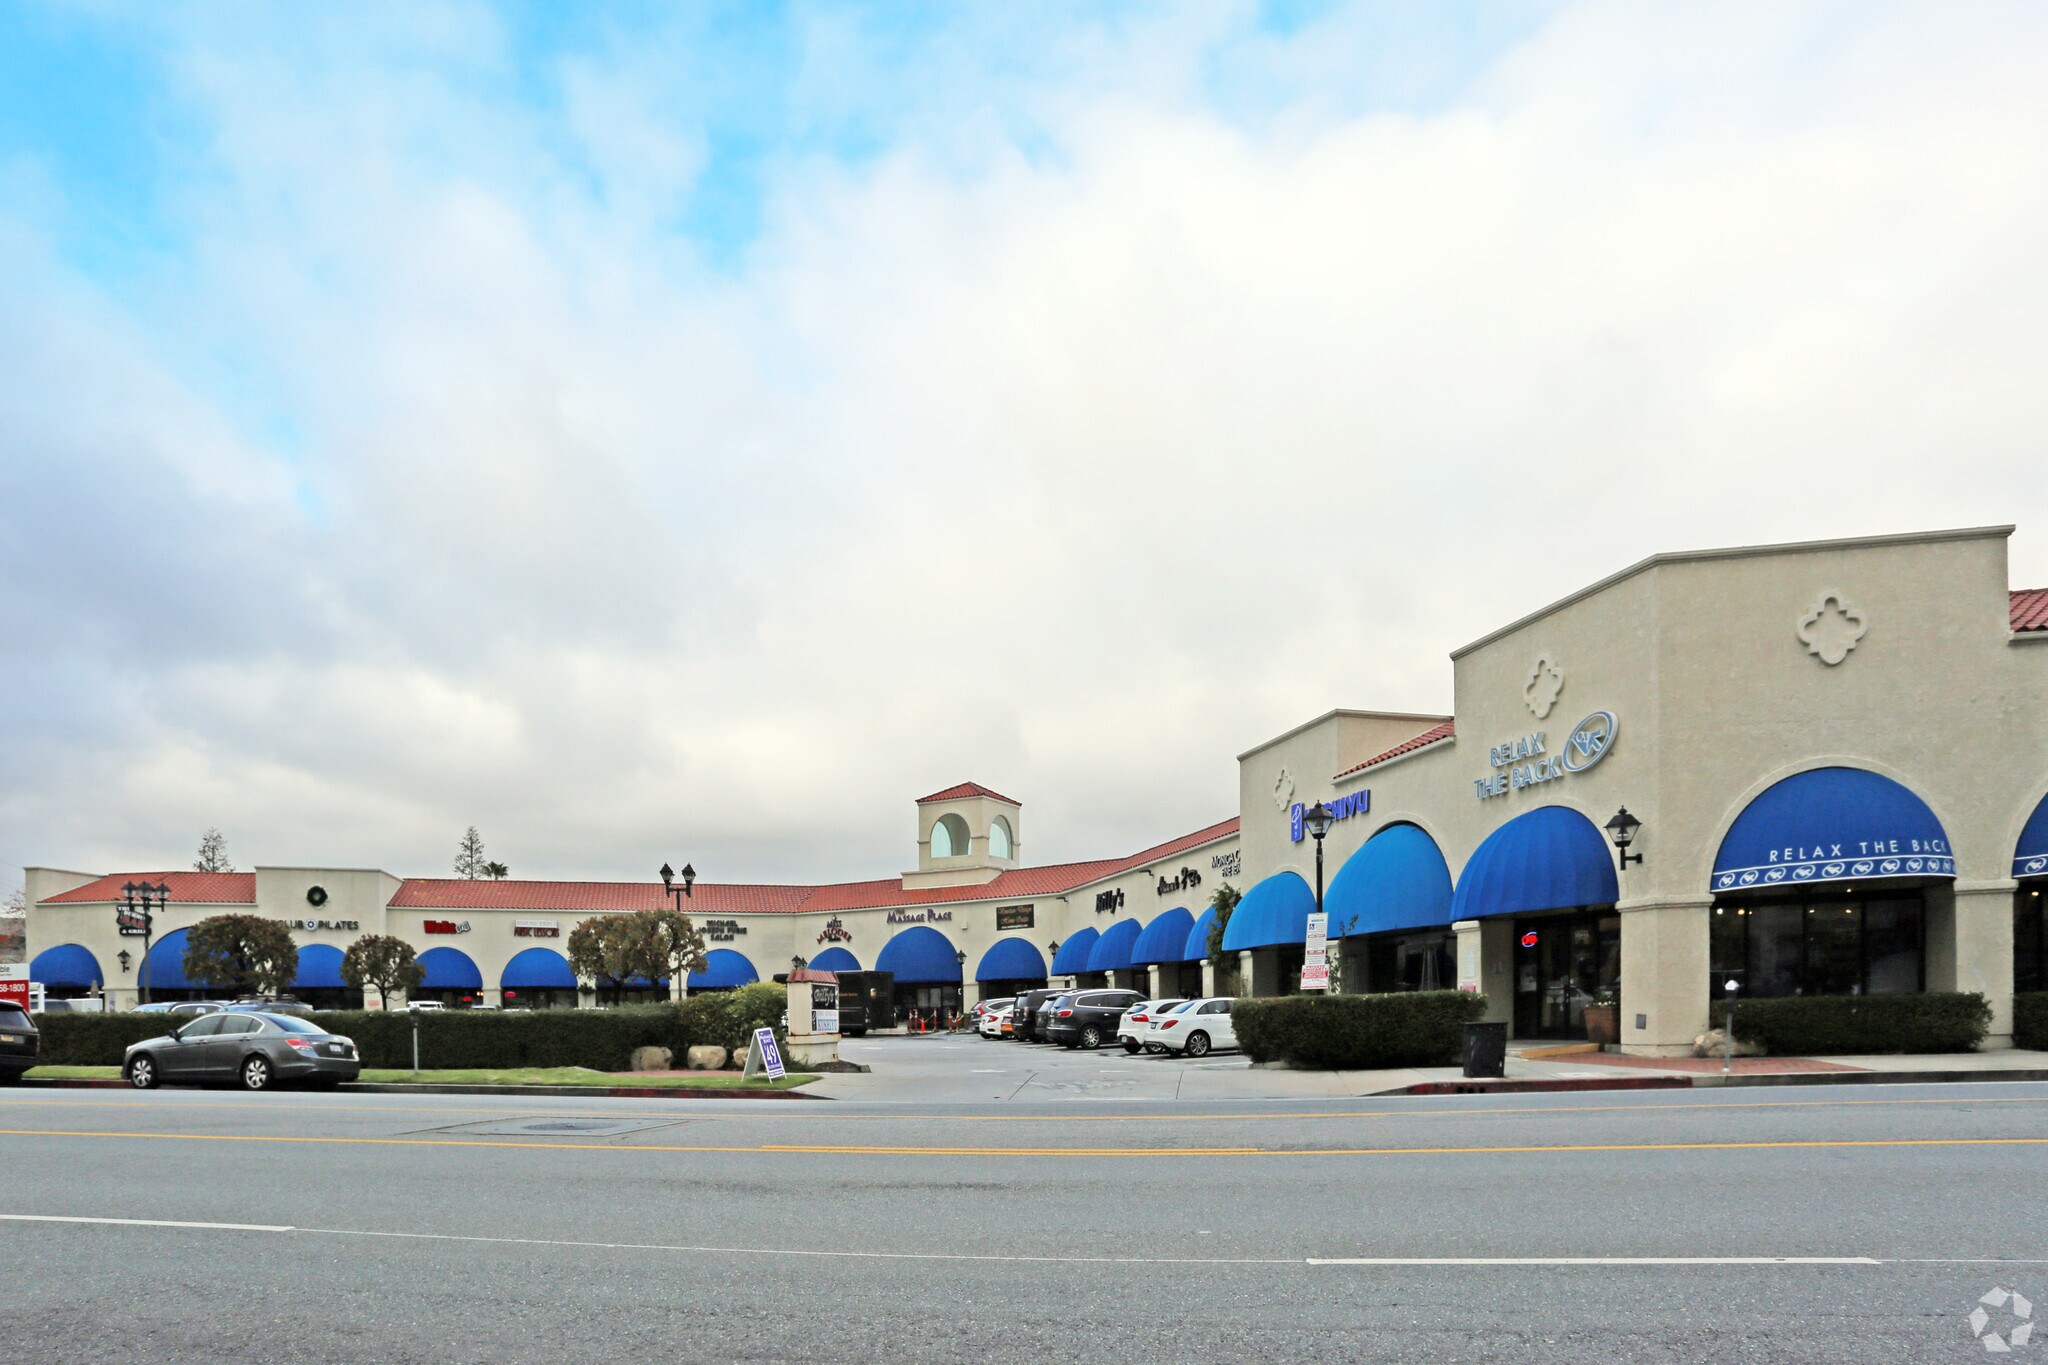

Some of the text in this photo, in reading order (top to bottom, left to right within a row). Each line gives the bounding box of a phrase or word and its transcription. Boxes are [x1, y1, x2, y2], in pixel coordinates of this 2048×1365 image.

[1490, 731, 1546, 768] RELAX
[1474, 755, 1564, 800] THE BACK
[1212, 852, 1235, 868] MONICA
[1769, 844, 1842, 862] RELAX
[1859, 840, 1899, 855] THE
[1095, 888, 1125, 914] Billy's
[318, 920, 359, 930] PILATES
[886, 909, 953, 924] MASSAGE PLACE
